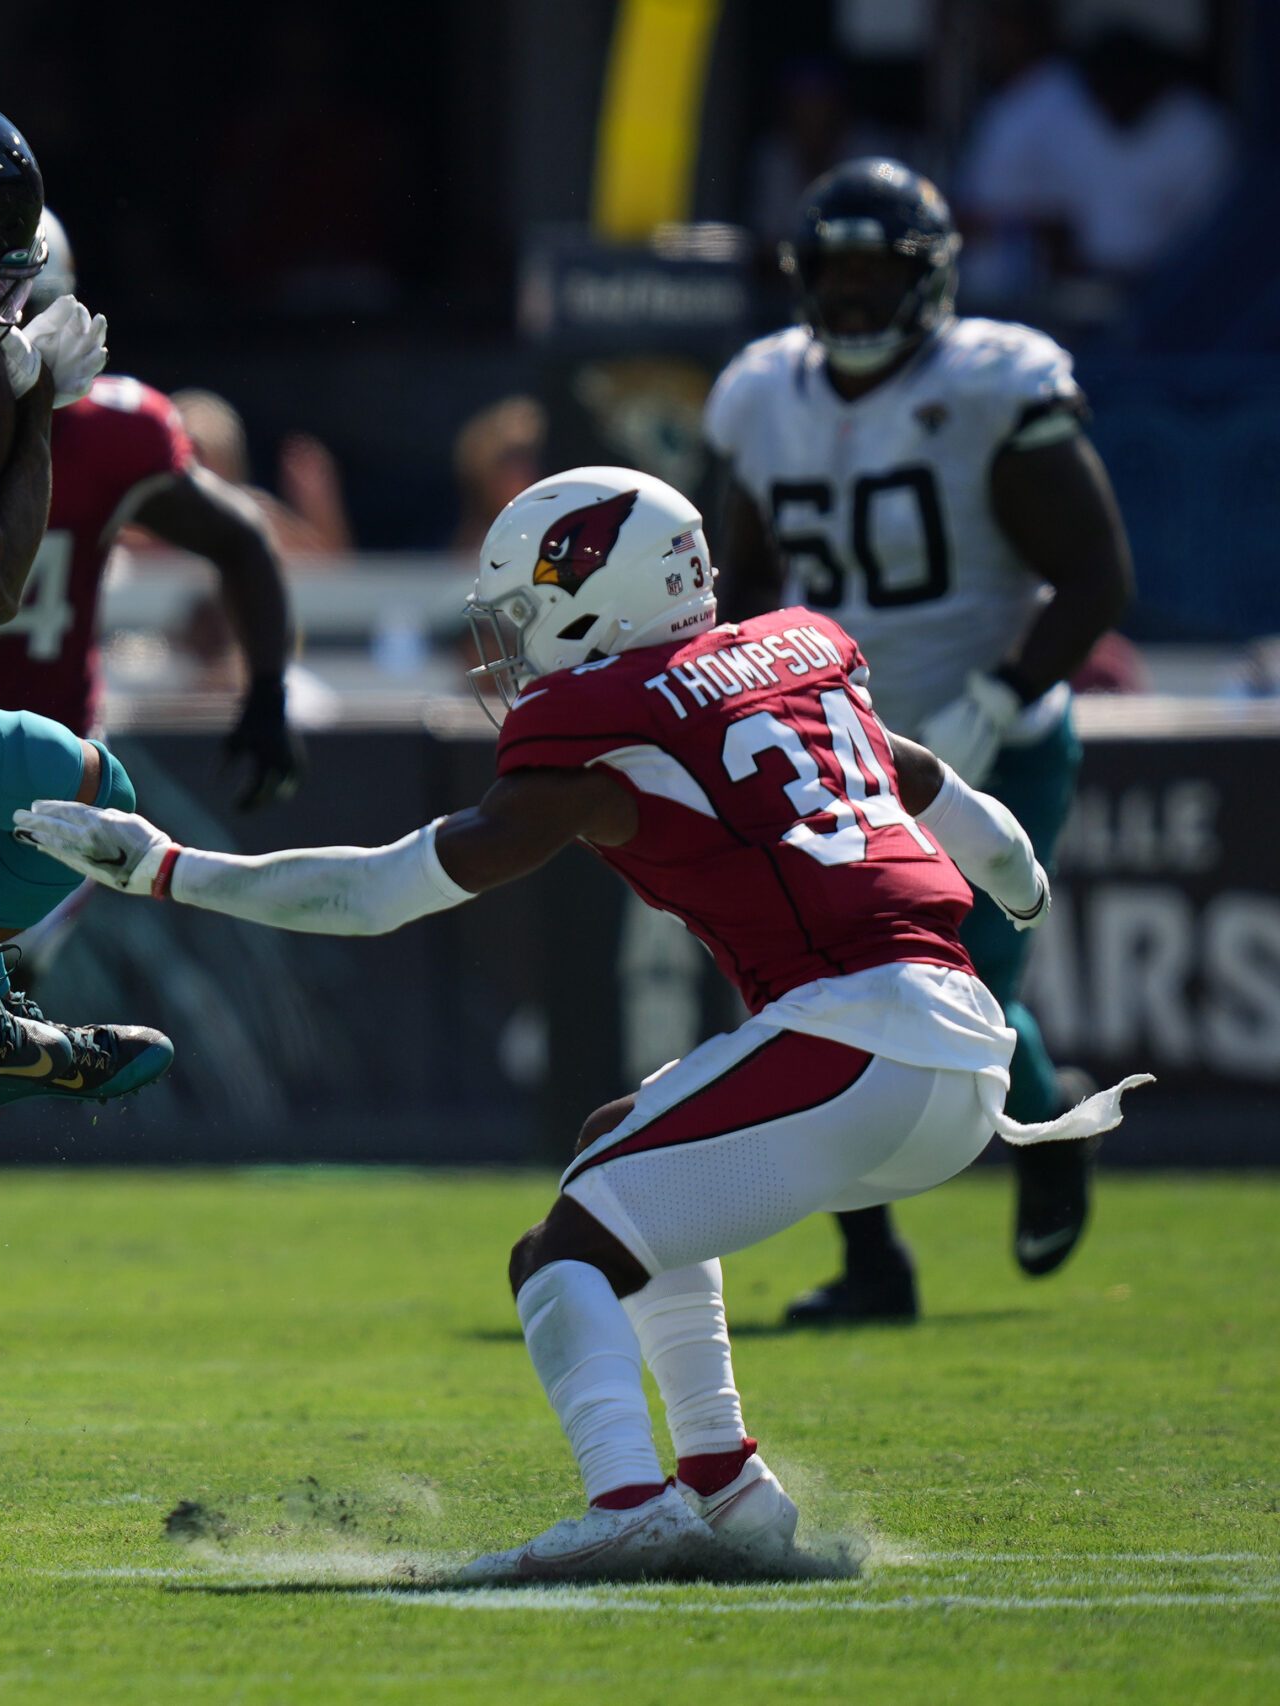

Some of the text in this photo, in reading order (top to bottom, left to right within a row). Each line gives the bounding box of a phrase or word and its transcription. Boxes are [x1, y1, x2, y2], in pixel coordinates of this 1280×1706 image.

[670, 614, 699, 633] BLACK
[643, 624, 843, 720] THOMPSON
[722, 688, 938, 867] 34
